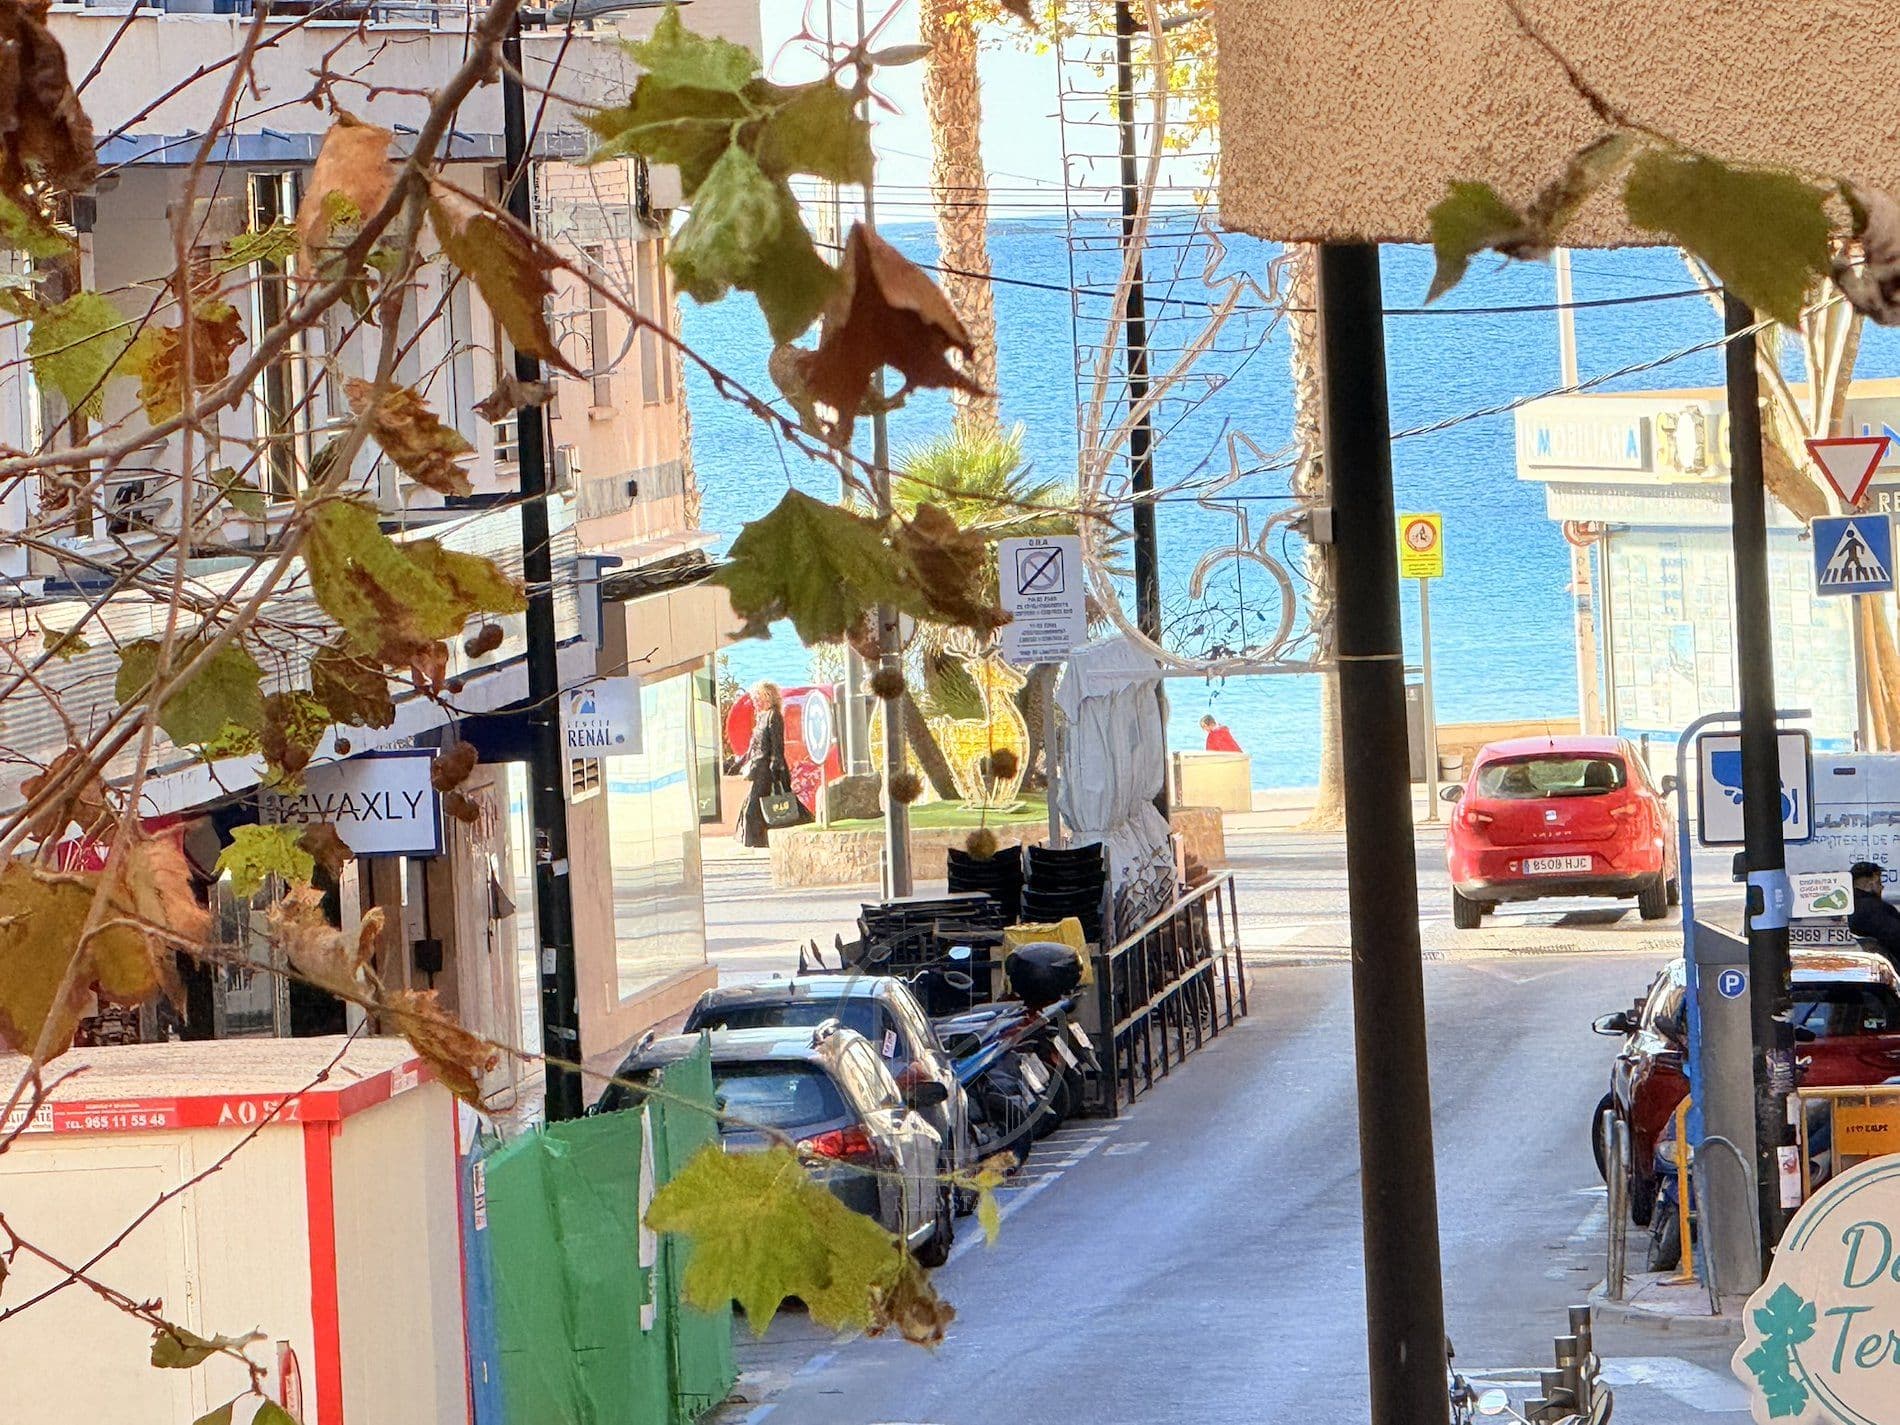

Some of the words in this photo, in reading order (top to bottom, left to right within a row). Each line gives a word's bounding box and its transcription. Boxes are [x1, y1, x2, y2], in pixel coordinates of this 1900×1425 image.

[568, 728, 613, 747] RENAL
[85, 1116, 109, 1129] 965
[112, 1115, 126, 1127] 11
[150, 1114, 165, 1126] 48
